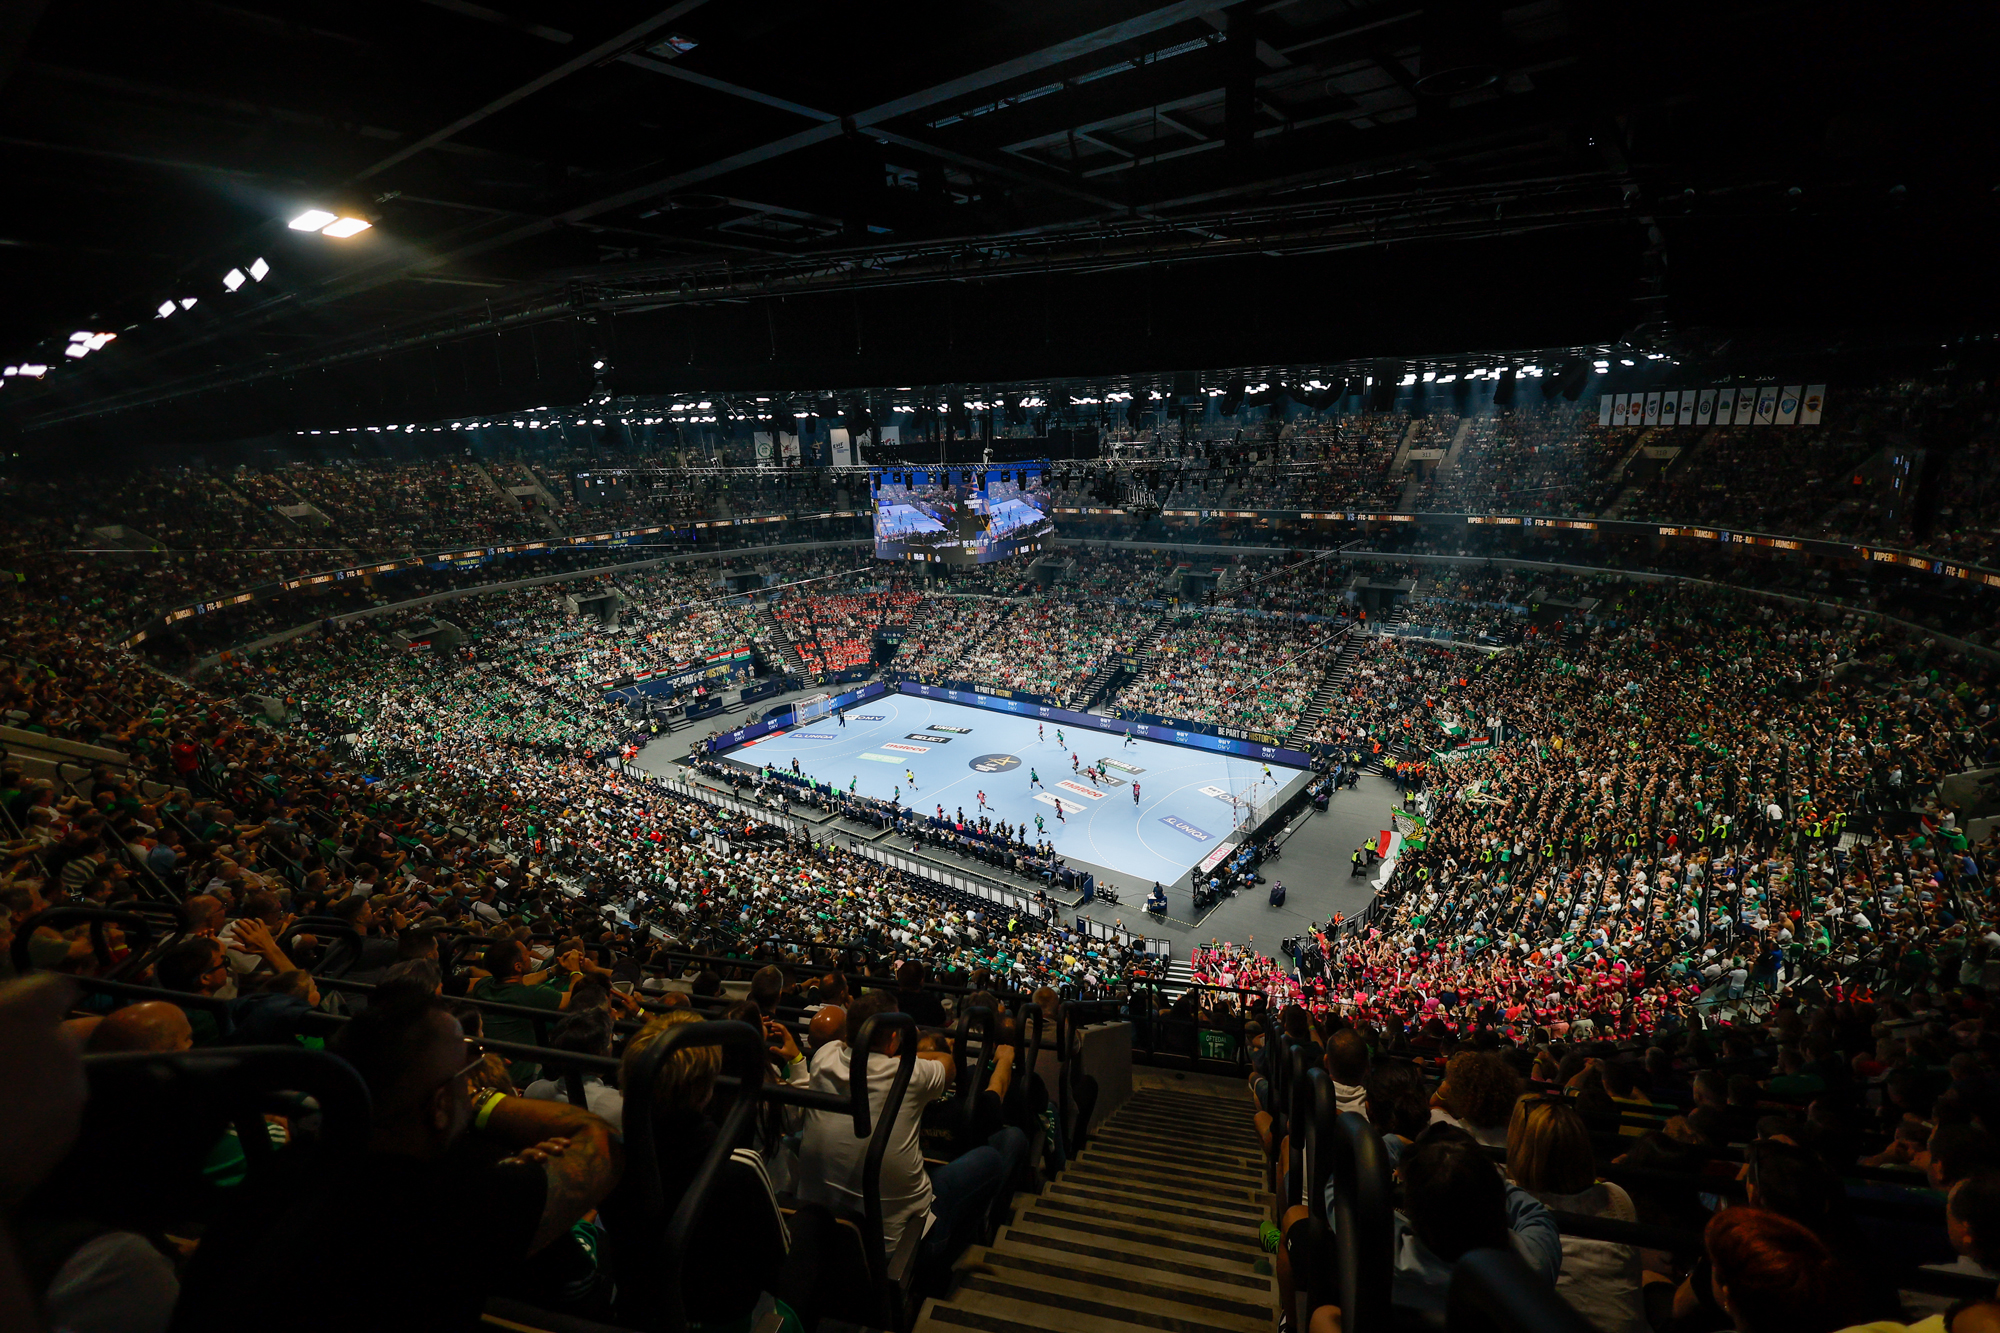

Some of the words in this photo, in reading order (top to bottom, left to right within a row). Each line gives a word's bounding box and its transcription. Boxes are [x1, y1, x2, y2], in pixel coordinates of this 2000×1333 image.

[1523, 518, 1532, 526] VS
[1721, 531, 1730, 542] VS
[1933, 561, 1943, 574] VS
[681, 673, 697, 685] PART
[698, 671, 705, 681] OF
[706, 664, 730, 678] HISTORY
[979, 686, 990, 695] PART
[996, 689, 1013, 698] HISTORY
[1218, 727, 1225, 735] BE
[1225, 728, 1240, 739] PART
[1240, 731, 1248, 739] OF
[1248, 733, 1272, 744] HISTORY
[886, 744, 927, 752] mateco
[1105, 758, 1142, 772] UNIBET
[1062, 782, 1103, 797] mateco
[1176, 820, 1208, 841] UNIQA
[1208, 1042, 1224, 1058] 15
